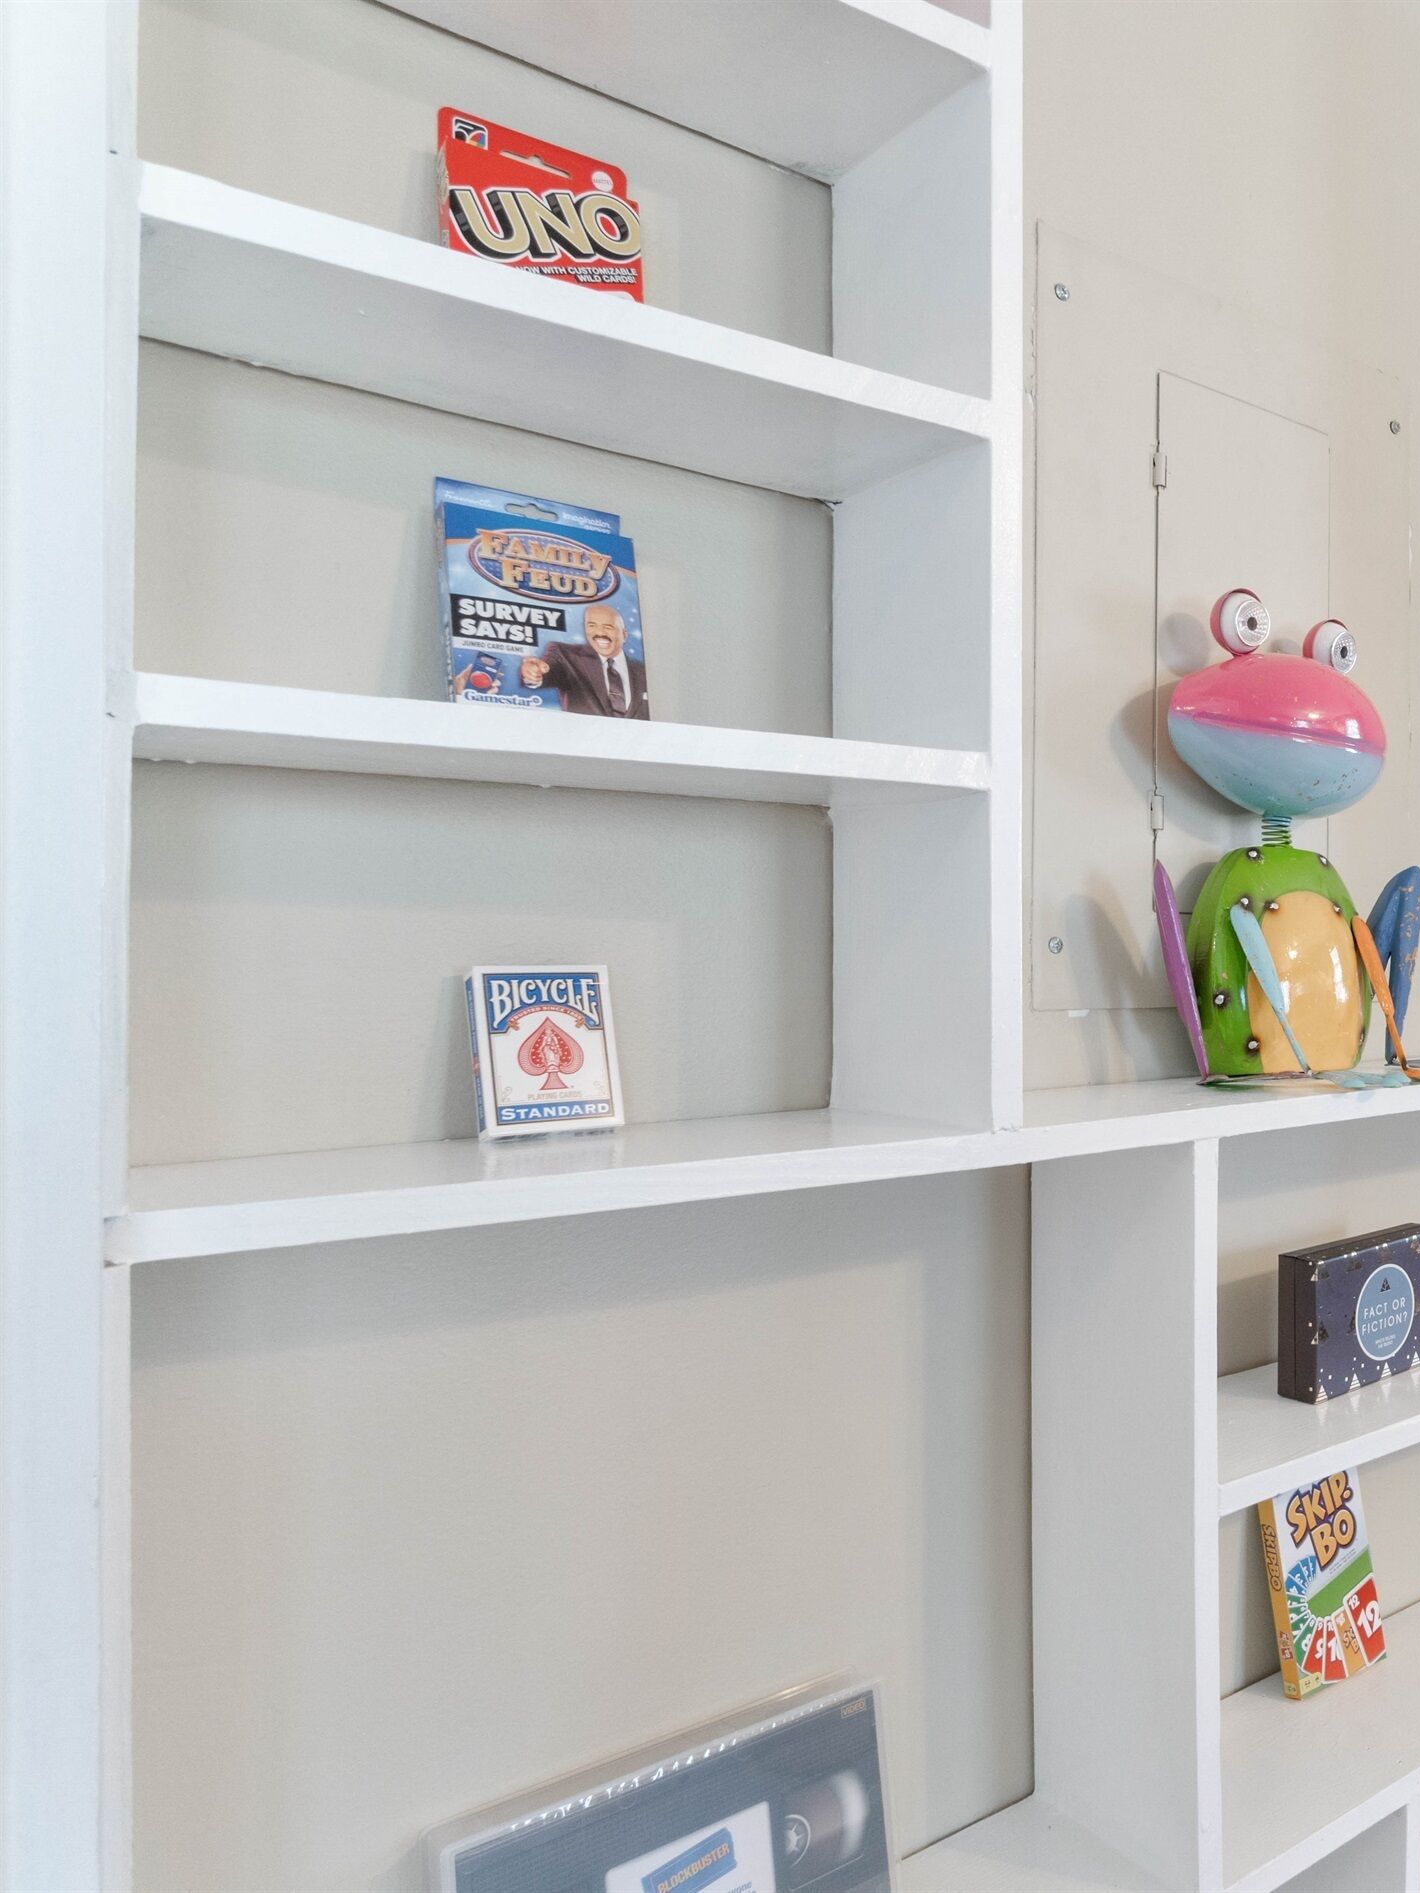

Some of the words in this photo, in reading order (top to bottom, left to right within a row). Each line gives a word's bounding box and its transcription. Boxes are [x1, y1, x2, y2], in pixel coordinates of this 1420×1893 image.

[449, 184, 642, 262] UNO
[542, 266, 569, 275] WITH
[569, 266, 638, 276] CUSTOMIZABLE
[576, 275, 601, 283] WILD
[602, 275, 637, 284] CARDS!
[476, 528, 612, 580] FAMILY
[501, 558, 598, 597] FEUD
[458, 598, 562, 627] SURVEY
[459, 618, 534, 643] SAYS!
[462, 640, 486, 648] JUMBO
[506, 645, 525, 653] GAME
[489, 978, 601, 1029] BICYCLE
[528, 1091, 557, 1101] PLAYING
[501, 1103, 610, 1121] STANDARD
[1363, 1302, 1388, 1320] FACT
[1392, 1297, 1406, 1310] OR
[1362, 1311, 1408, 1336] FICTION?
[1310, 1508, 1357, 1571] BO
[1348, 1594, 1360, 1610] 12
[1357, 1600, 1383, 1638] 12
[657, 1842, 731, 1893] BLOCKBUSTER
